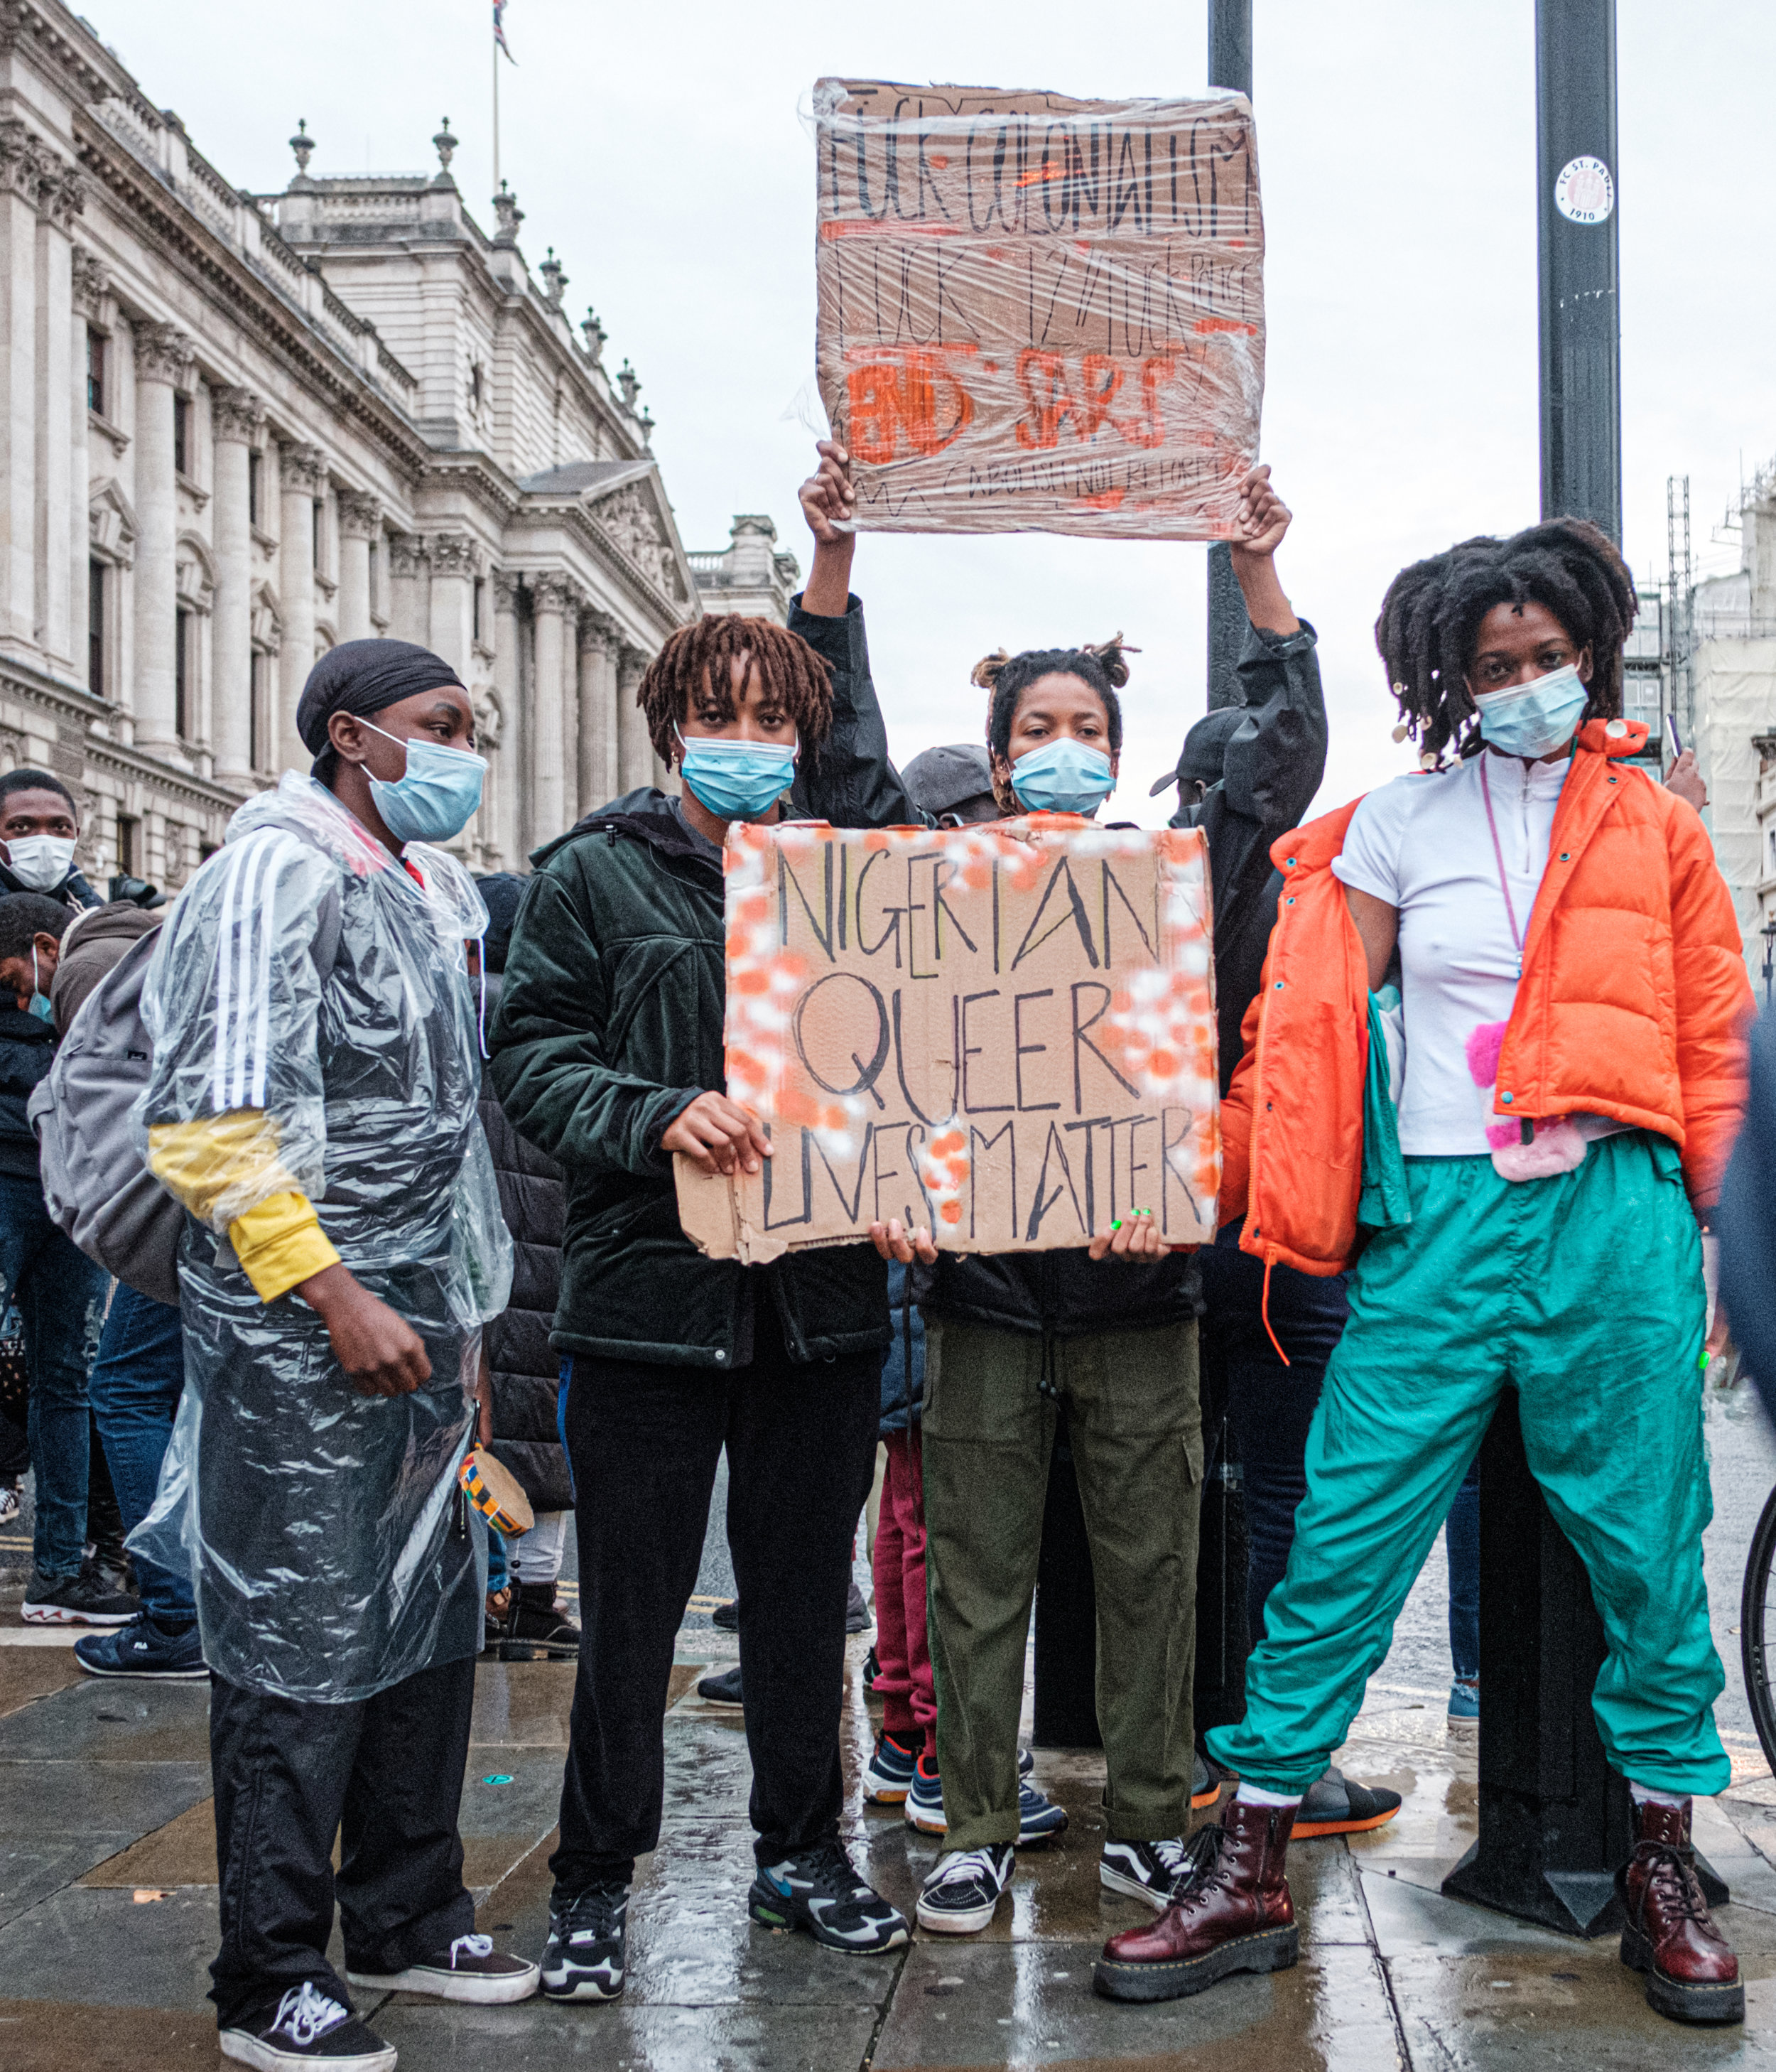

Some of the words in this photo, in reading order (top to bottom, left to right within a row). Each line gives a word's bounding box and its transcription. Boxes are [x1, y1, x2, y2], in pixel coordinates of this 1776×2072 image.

[829, 89, 952, 220] FUCK
[966, 107, 1250, 237] COLONIALISM
[1559, 171, 1571, 185] FC
[1572, 160, 1588, 171] ST.
[1570, 208, 1595, 220] 1910
[835, 239, 981, 360] FUCK
[848, 350, 974, 464] END
[777, 841, 1160, 979] NIGERIAN
[791, 972, 1141, 1127] QUEER
[762, 1121, 937, 1241] LIVES
[970, 1106, 1202, 1241] MATTER
